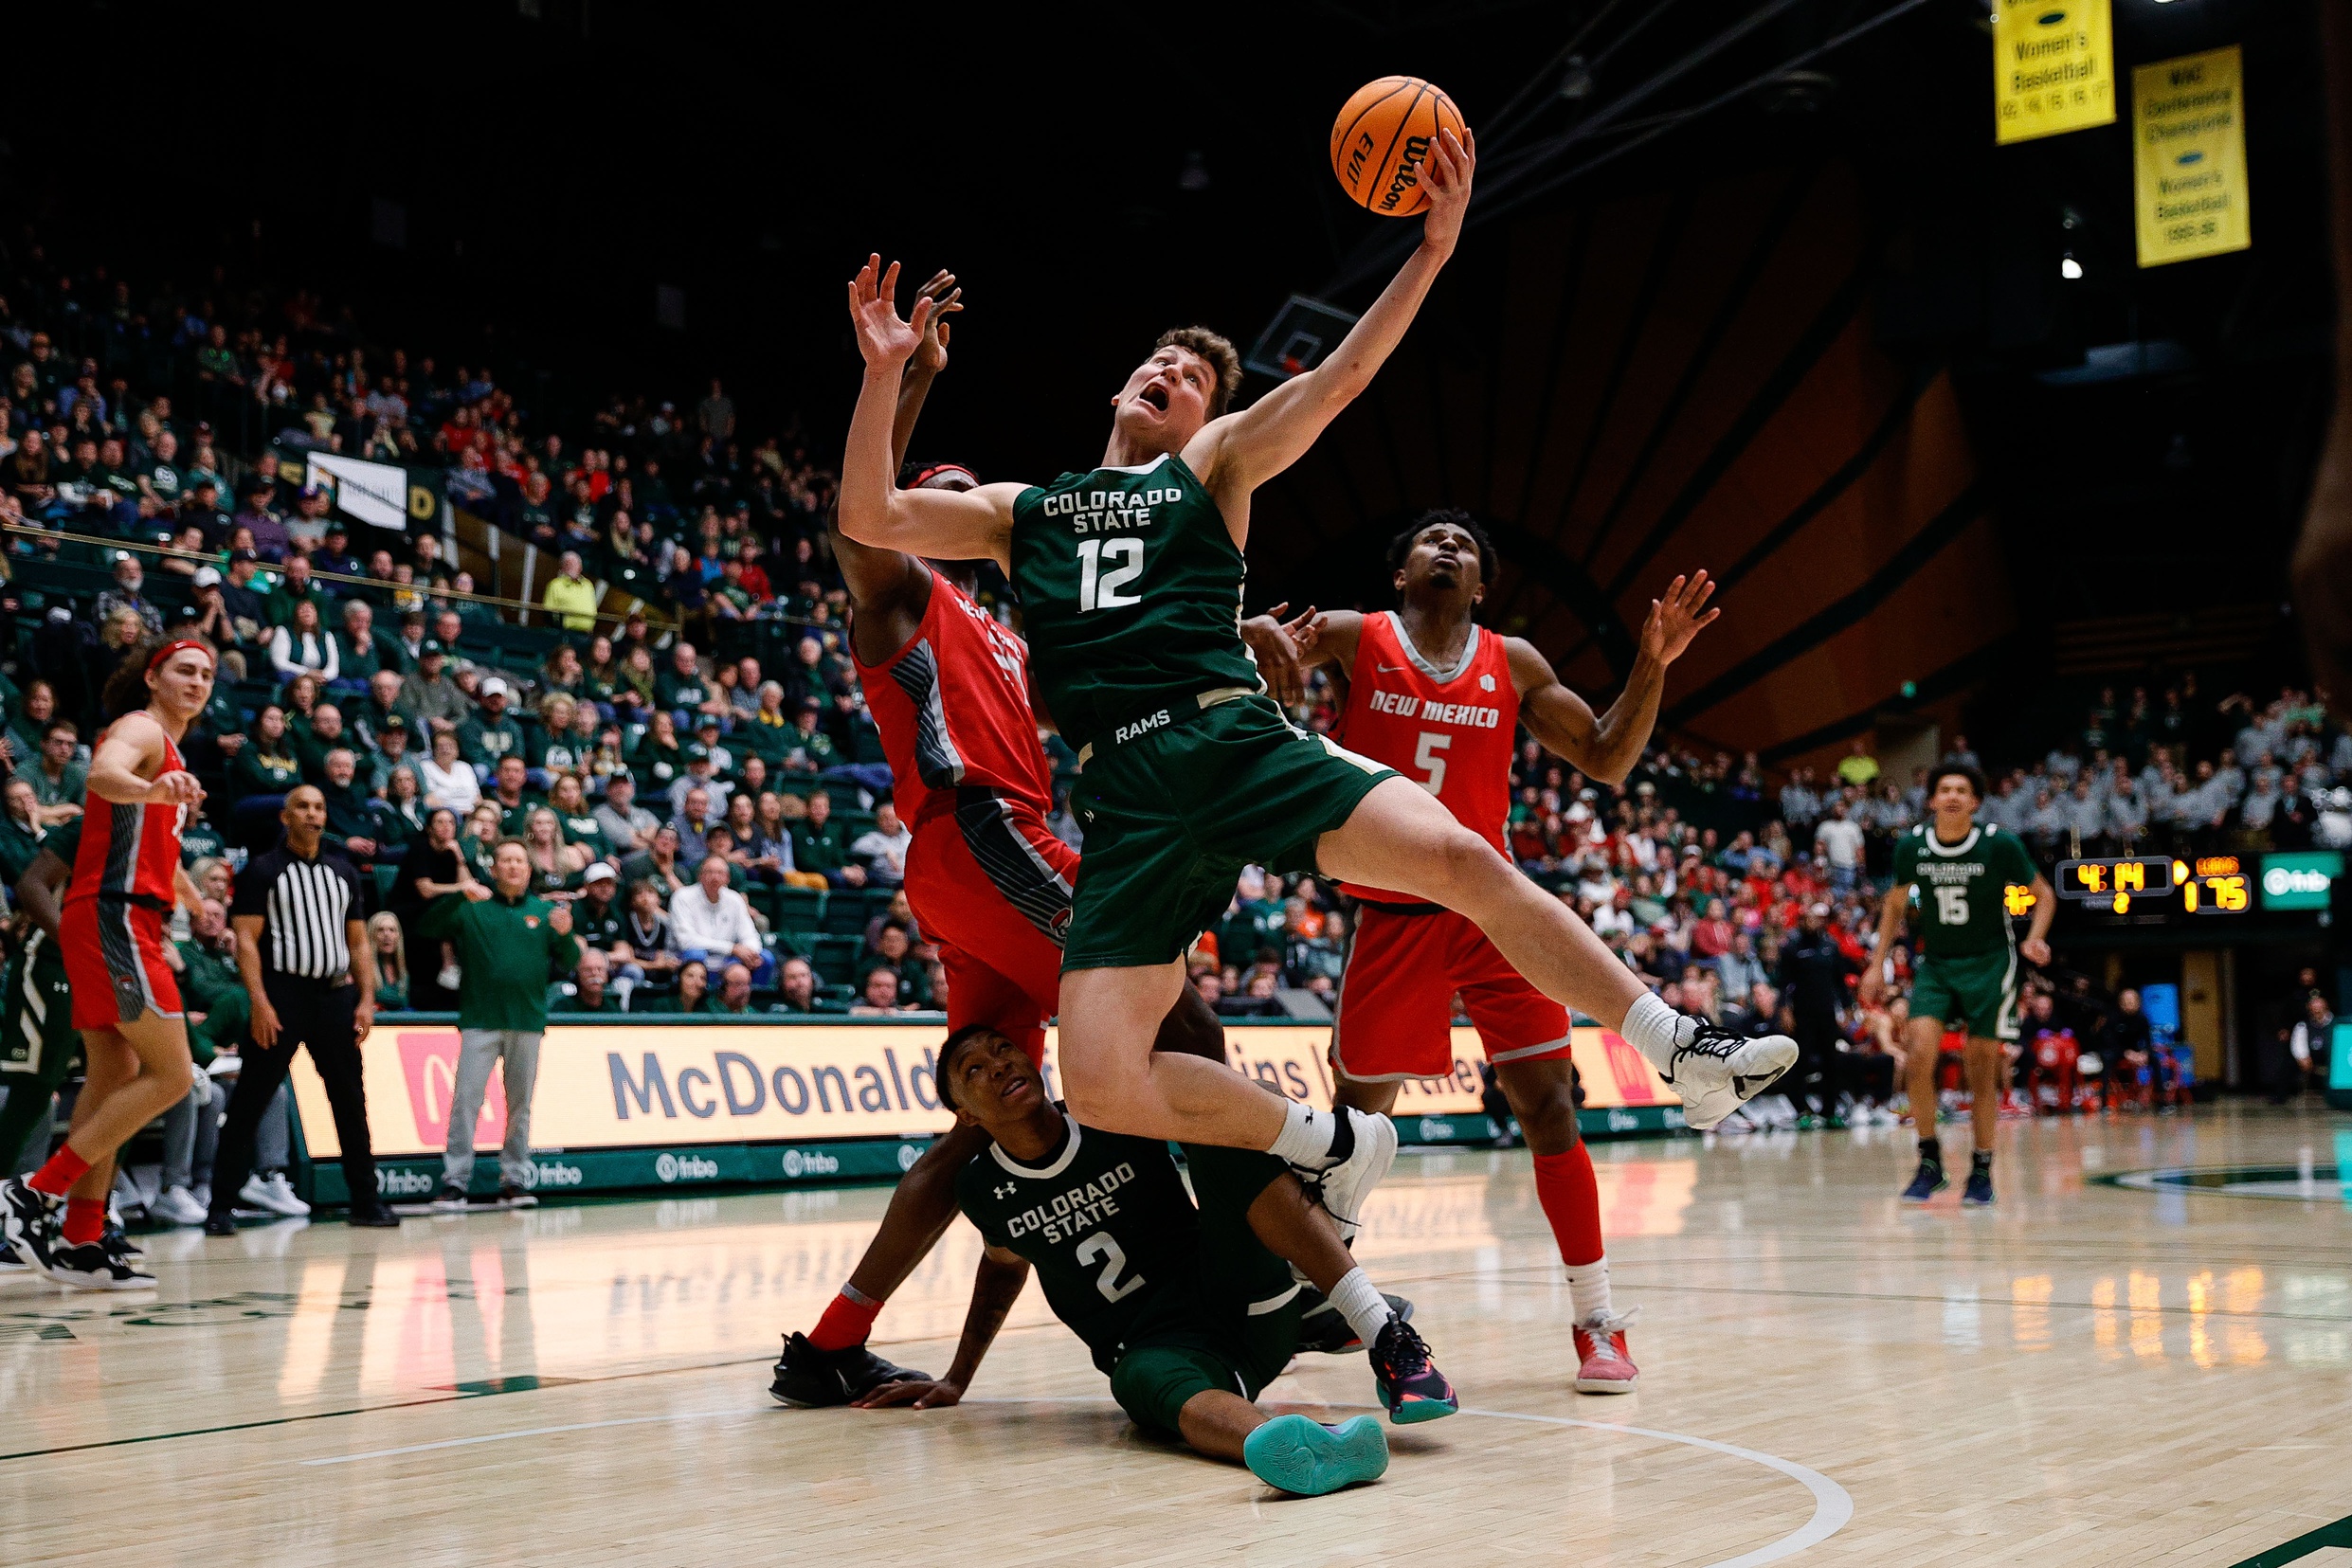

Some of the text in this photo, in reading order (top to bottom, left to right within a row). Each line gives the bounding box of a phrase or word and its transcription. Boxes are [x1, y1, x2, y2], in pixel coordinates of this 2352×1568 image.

[1379, 135, 1432, 210] Wilson
[1043, 488, 1183, 517] COLORADO
[1073, 508, 1151, 534] STATE
[1076, 536, 1145, 613] 12
[1115, 710, 1171, 745] RAMS
[1369, 690, 1500, 730] NEW MEXICO
[1414, 730, 1453, 797] 5
[2078, 861, 2144, 893] 4:14
[1933, 885, 1970, 926] 15
[1006, 1162, 1136, 1238] COLORADO
[1042, 1196, 1120, 1245] STATE
[1076, 1231, 1147, 1305] 2
